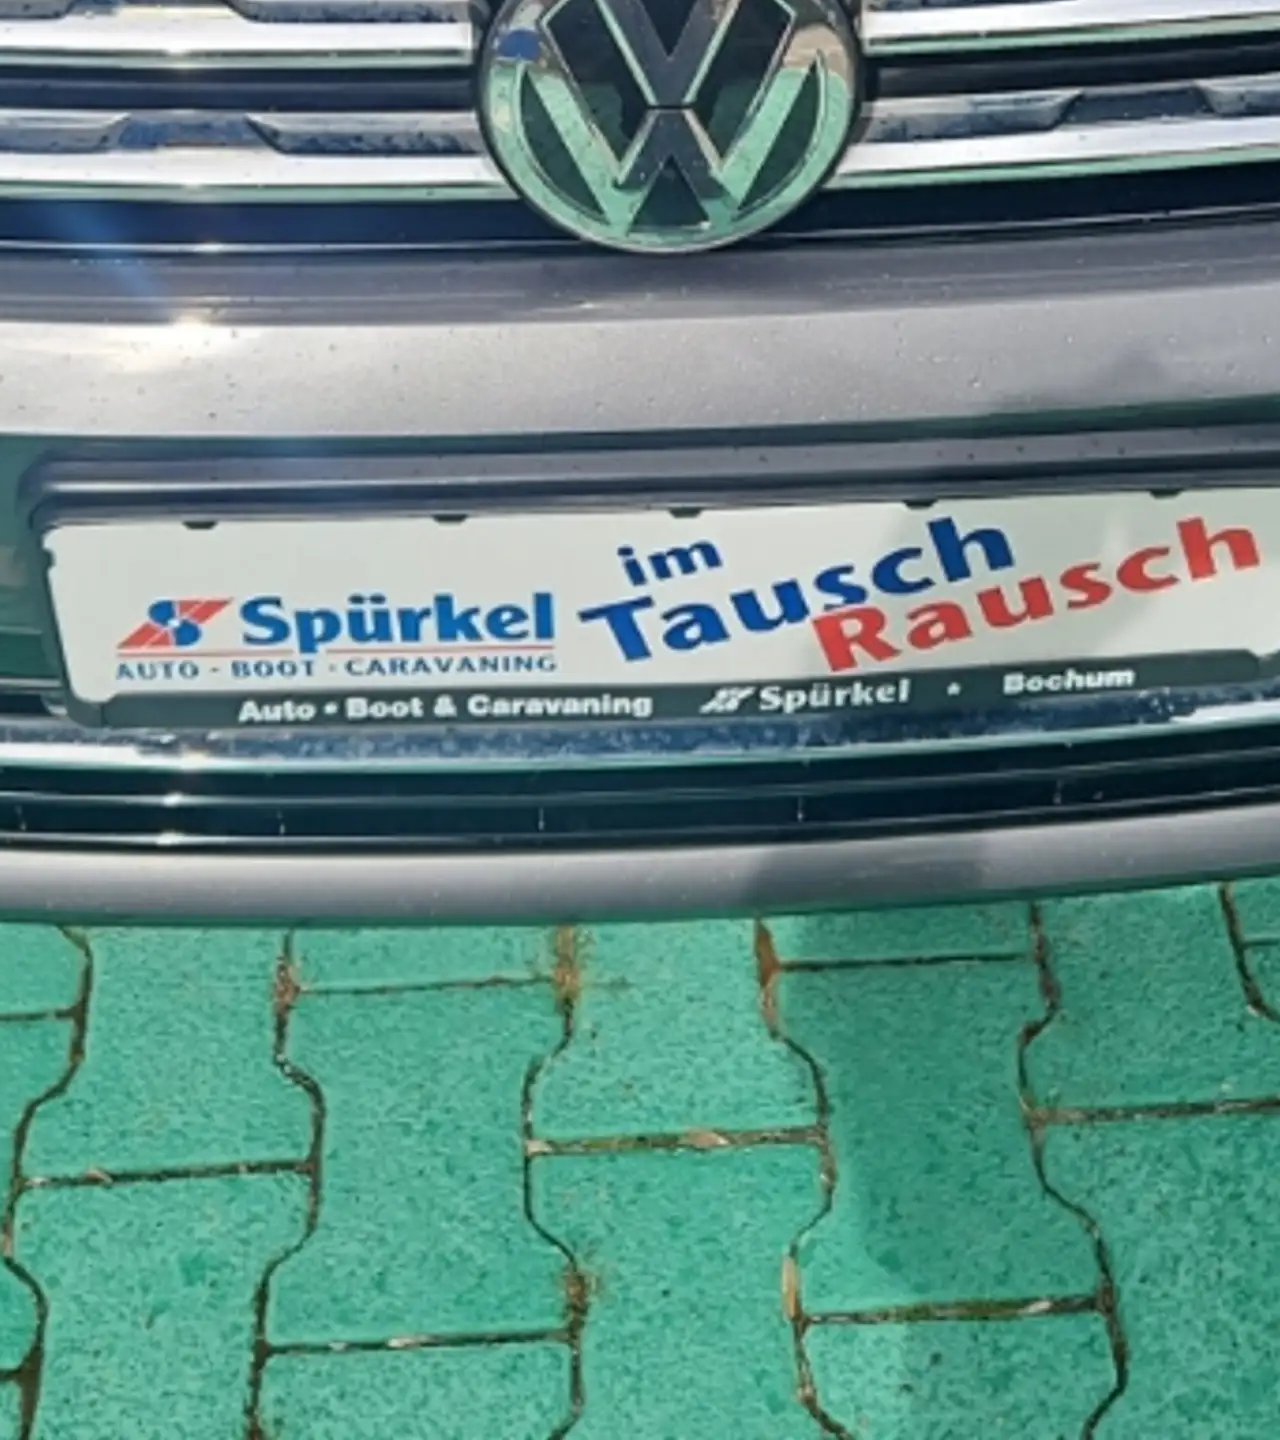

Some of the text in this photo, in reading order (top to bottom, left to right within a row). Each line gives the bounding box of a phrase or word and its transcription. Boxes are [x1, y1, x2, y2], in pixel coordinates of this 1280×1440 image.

[578, 517, 1016, 663] Tausch
[617, 538, 722, 587] im
[240, 592, 555, 654] Spürkel
[812, 517, 1261, 672] Rausch
[115, 654, 557, 681] AUTO BOOT CARAVANING
[238, 668, 1135, 722] Auto Boot & Caravaning Spürkel Bochum
